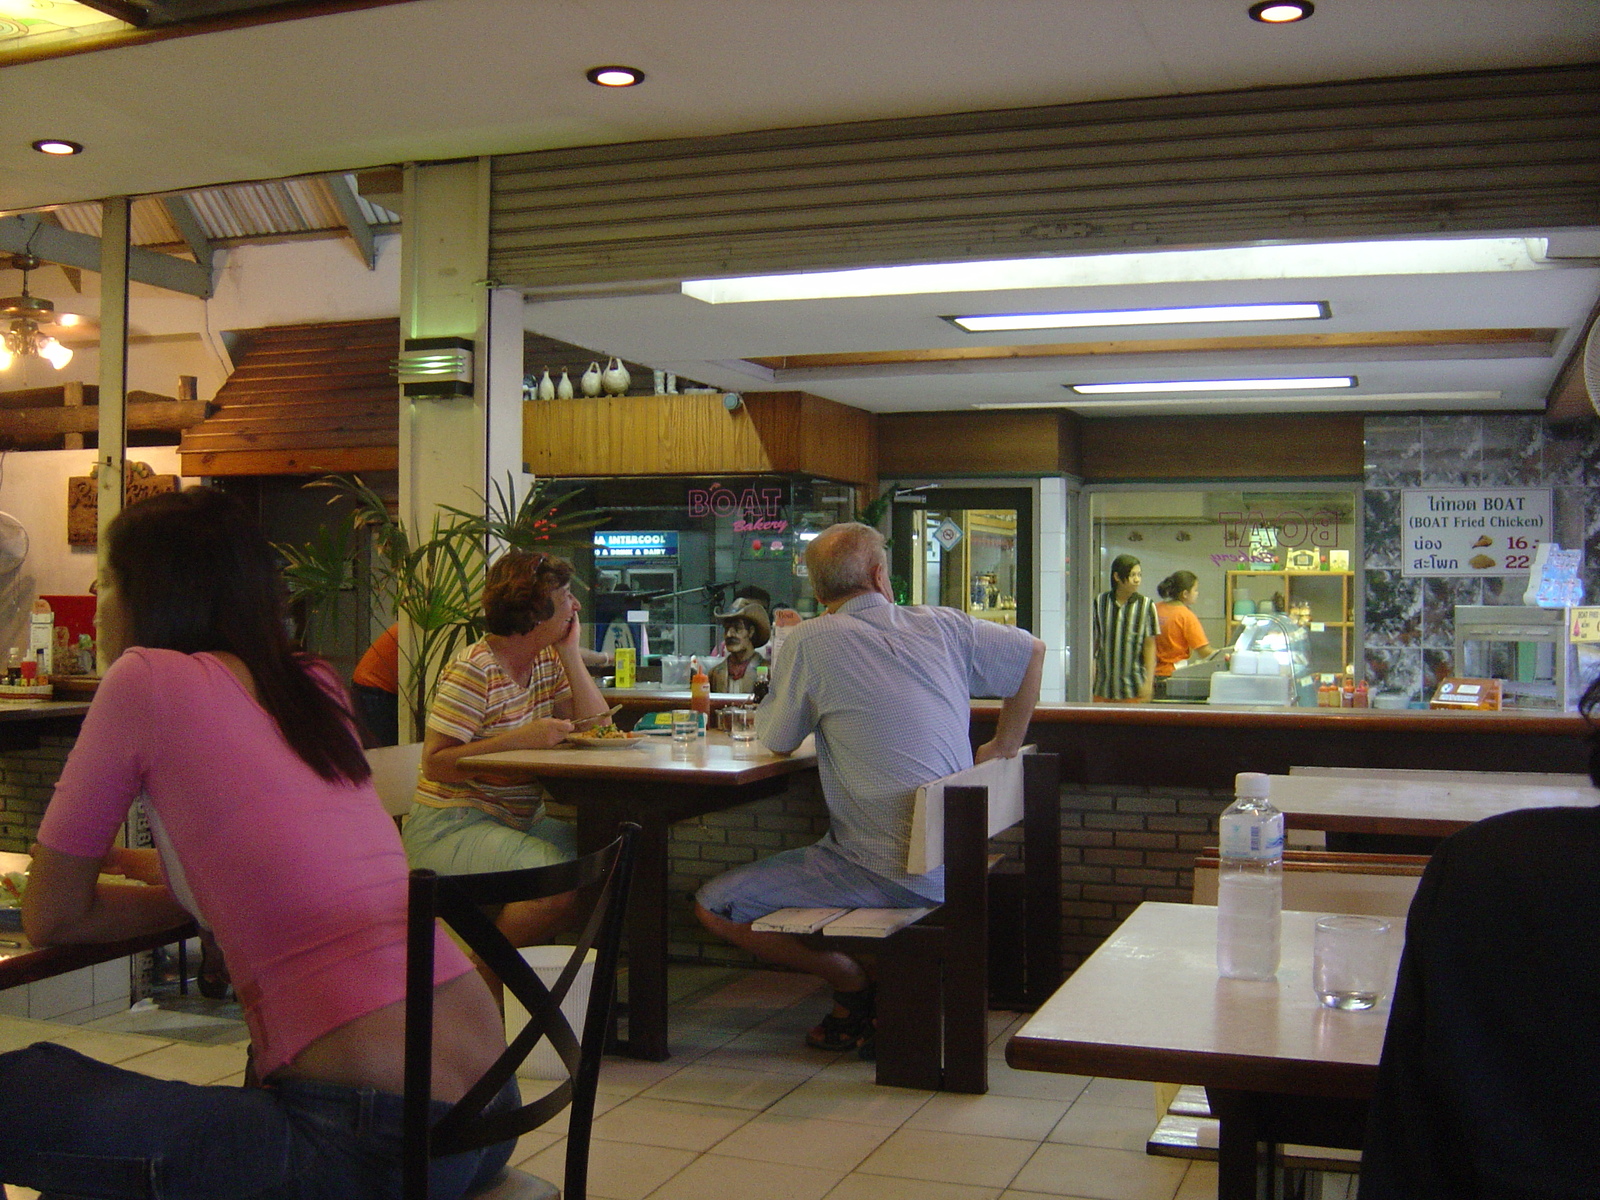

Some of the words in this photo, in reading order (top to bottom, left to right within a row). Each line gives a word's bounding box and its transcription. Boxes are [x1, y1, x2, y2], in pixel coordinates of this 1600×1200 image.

[688, 489, 782, 518] BOAT
[1427, 496, 1477, 511] ไก่ทอด
[1483, 497, 1526, 511] BOAT
[732, 517, 788, 534] Bakery
[1409, 516, 1449, 529] (BOAT
[1454, 516, 1485, 528] Fried
[1490, 514, 1544, 528] Chicken)
[608, 535, 666, 545] INTERCOOL
[1414, 536, 1442, 550] น่อง
[610, 548, 633, 556] DRINK
[643, 548, 666, 556] DAIRY
[1413, 554, 1459, 569] สะโพก
[1505, 555, 1530, 569] 22
